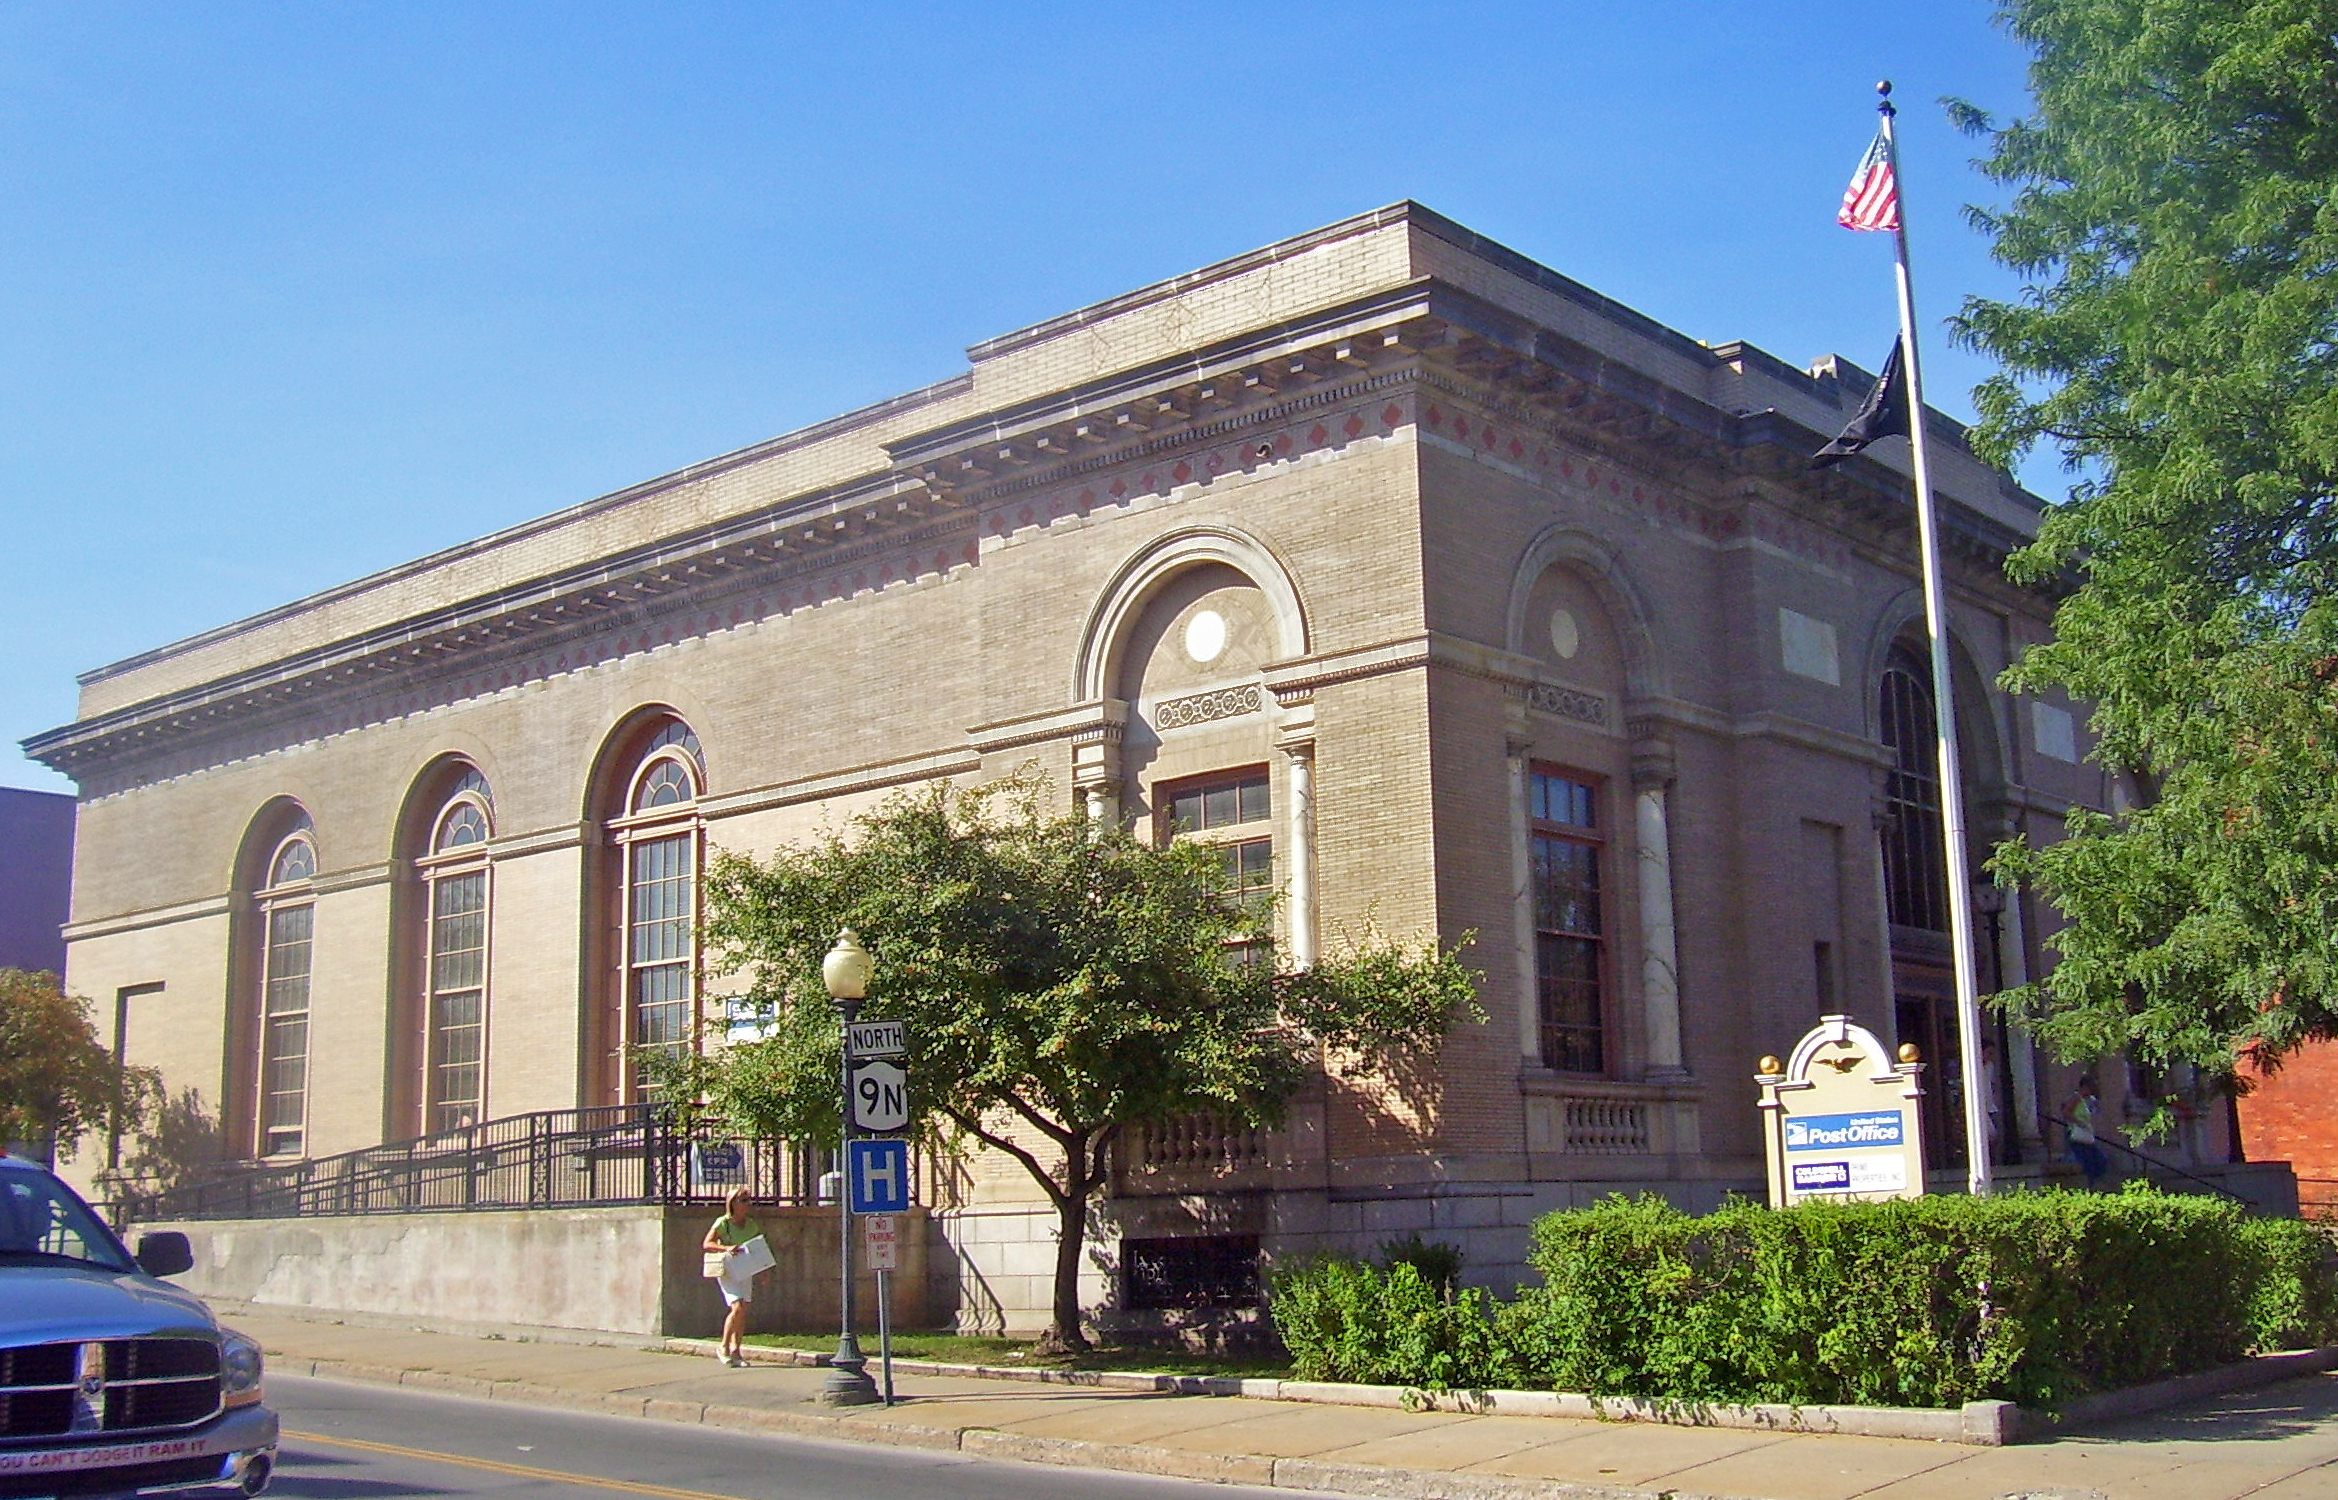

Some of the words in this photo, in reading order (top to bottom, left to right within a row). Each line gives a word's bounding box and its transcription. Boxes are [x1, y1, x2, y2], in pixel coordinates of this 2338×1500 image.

[853, 1027, 903, 1049] NORTH
[859, 1077, 903, 1116] 9N
[1808, 1127, 1848, 1144] Post
[1847, 1124, 1899, 1142] Office
[863, 1151, 897, 1202] H
[875, 1219, 887, 1230] NO
[0, 1455, 23, 1469] OU
[150, 1442, 186, 1456] RAM
[190, 1439, 206, 1451] IT
